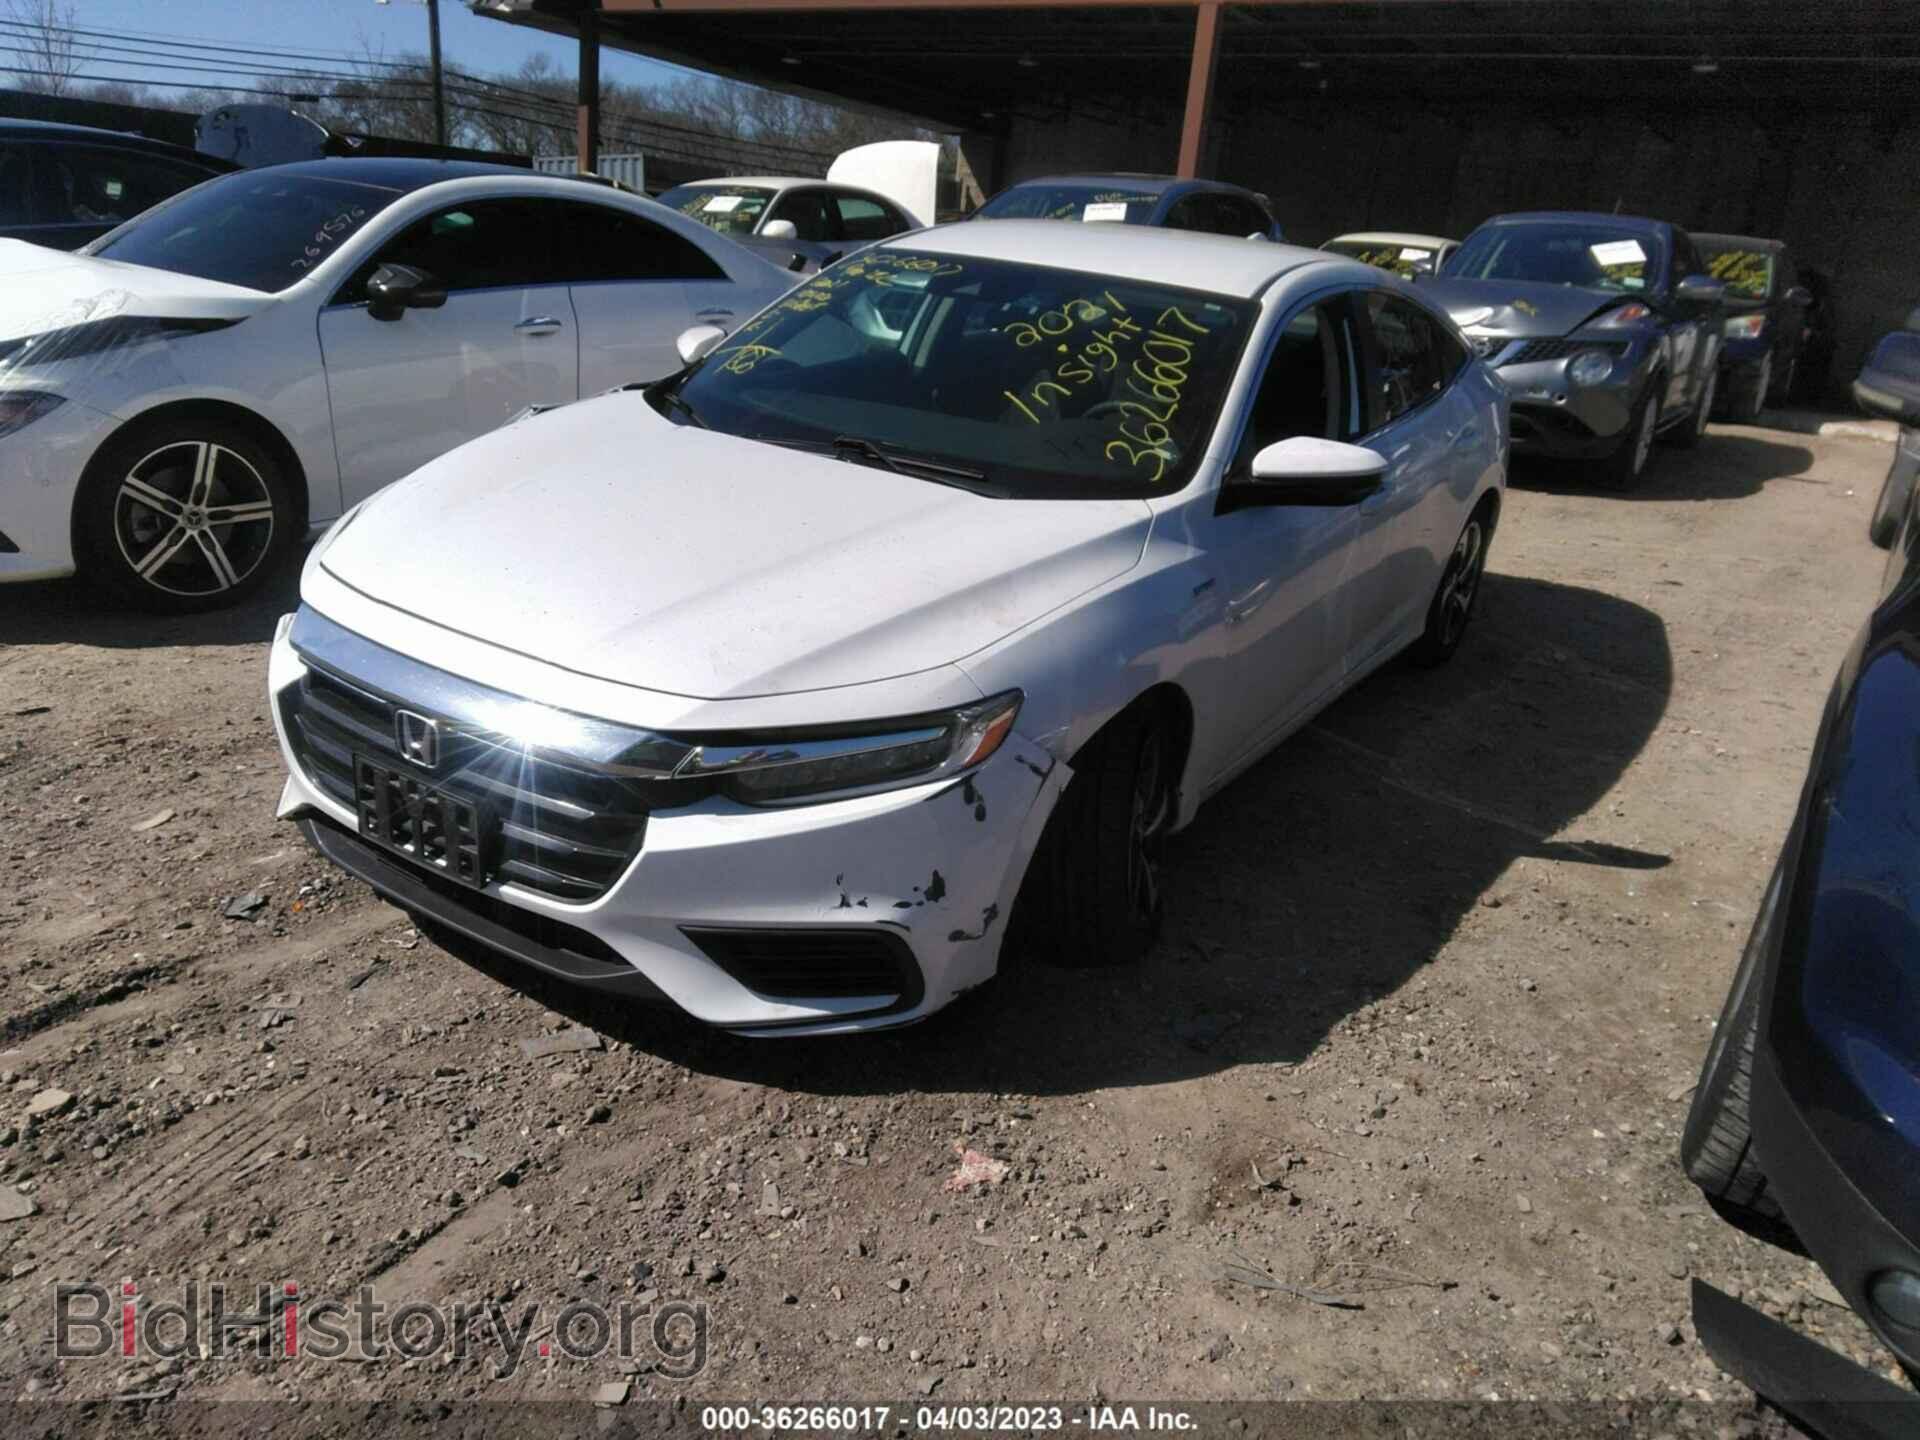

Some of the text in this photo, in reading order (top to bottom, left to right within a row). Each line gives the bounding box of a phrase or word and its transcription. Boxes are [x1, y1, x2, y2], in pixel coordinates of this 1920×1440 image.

[1004, 291, 1126, 346] 2021
[1004, 317, 1142, 423] Insight
[1106, 307, 1210, 481] 36266017
